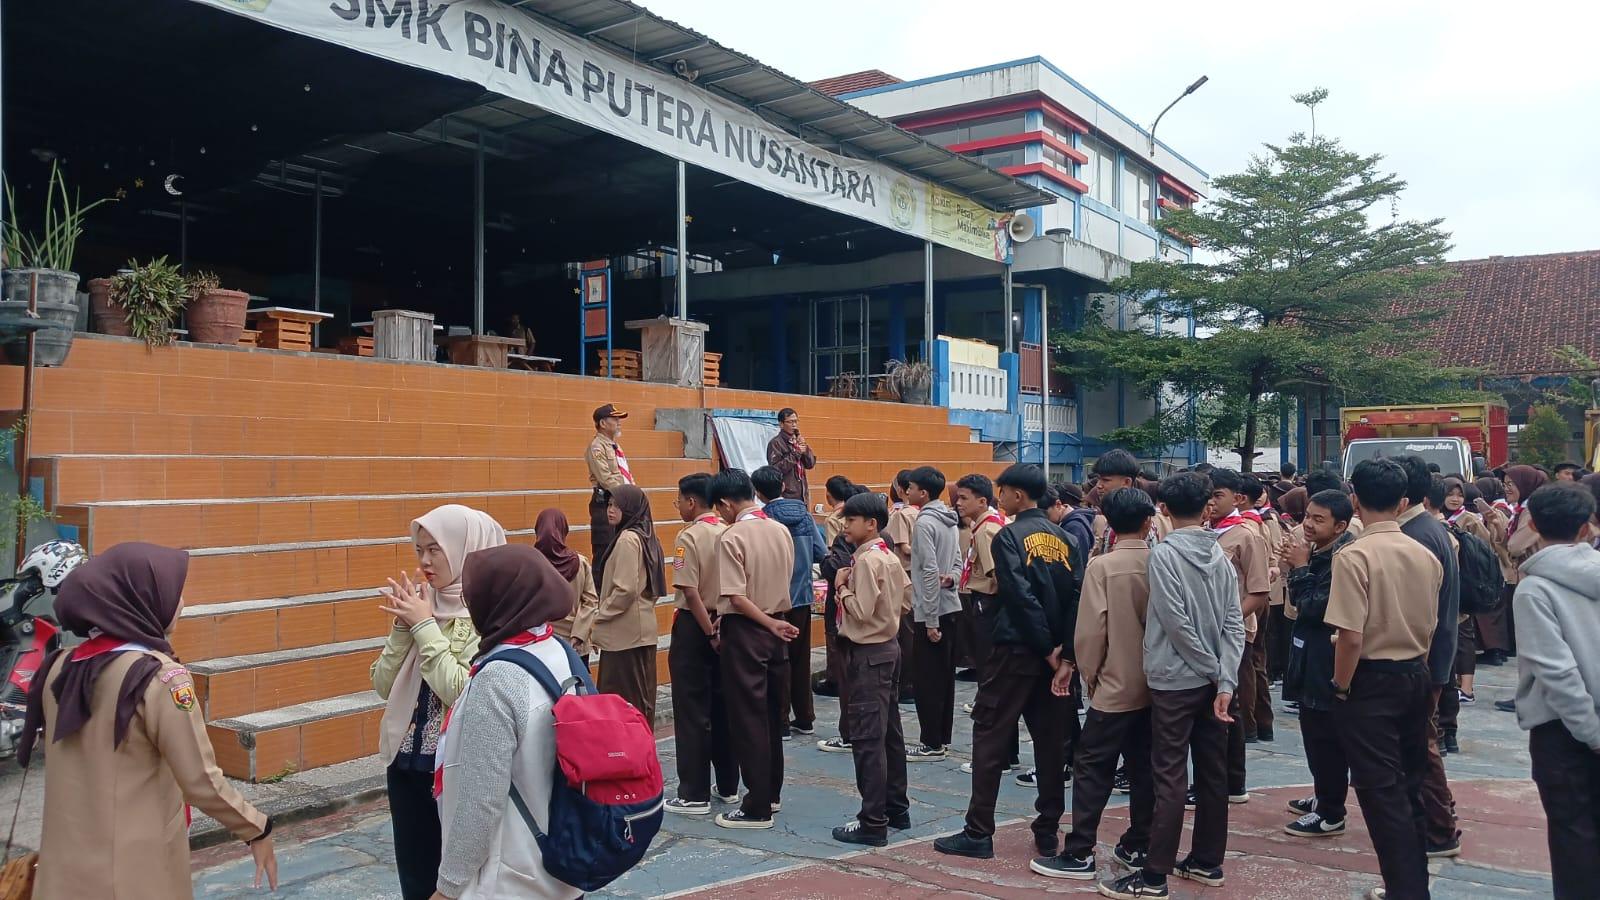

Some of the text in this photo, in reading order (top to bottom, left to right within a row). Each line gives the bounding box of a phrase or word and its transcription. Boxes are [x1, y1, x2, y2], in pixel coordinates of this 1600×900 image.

[464, 10, 573, 97] BINA
[582, 60, 718, 154] PUTERA
[725, 120, 876, 207] NUSANTARA
